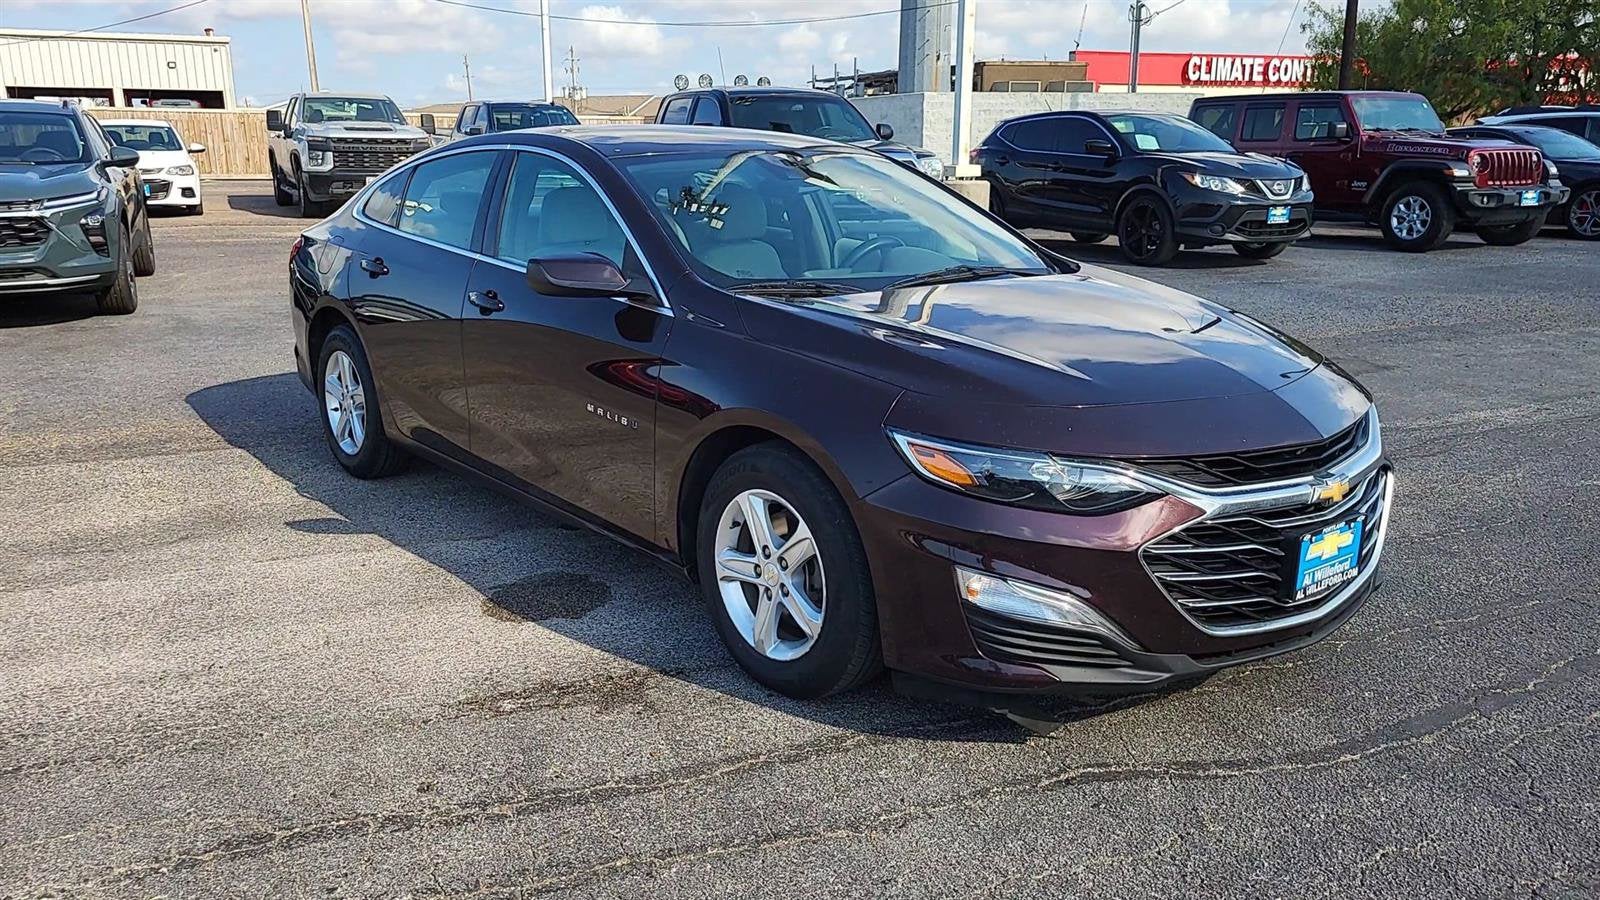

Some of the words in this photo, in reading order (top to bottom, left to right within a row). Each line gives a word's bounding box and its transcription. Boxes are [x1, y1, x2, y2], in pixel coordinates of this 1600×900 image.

[1187, 56, 1264, 82] CLIMATE
[1267, 57, 1319, 82] CONT
[586, 403, 638, 429] MALIBU
[1314, 557, 1351, 582] Willeford
[1295, 588, 1305, 601] AL
[1305, 566, 1359, 596] WILLEFORD.COM
